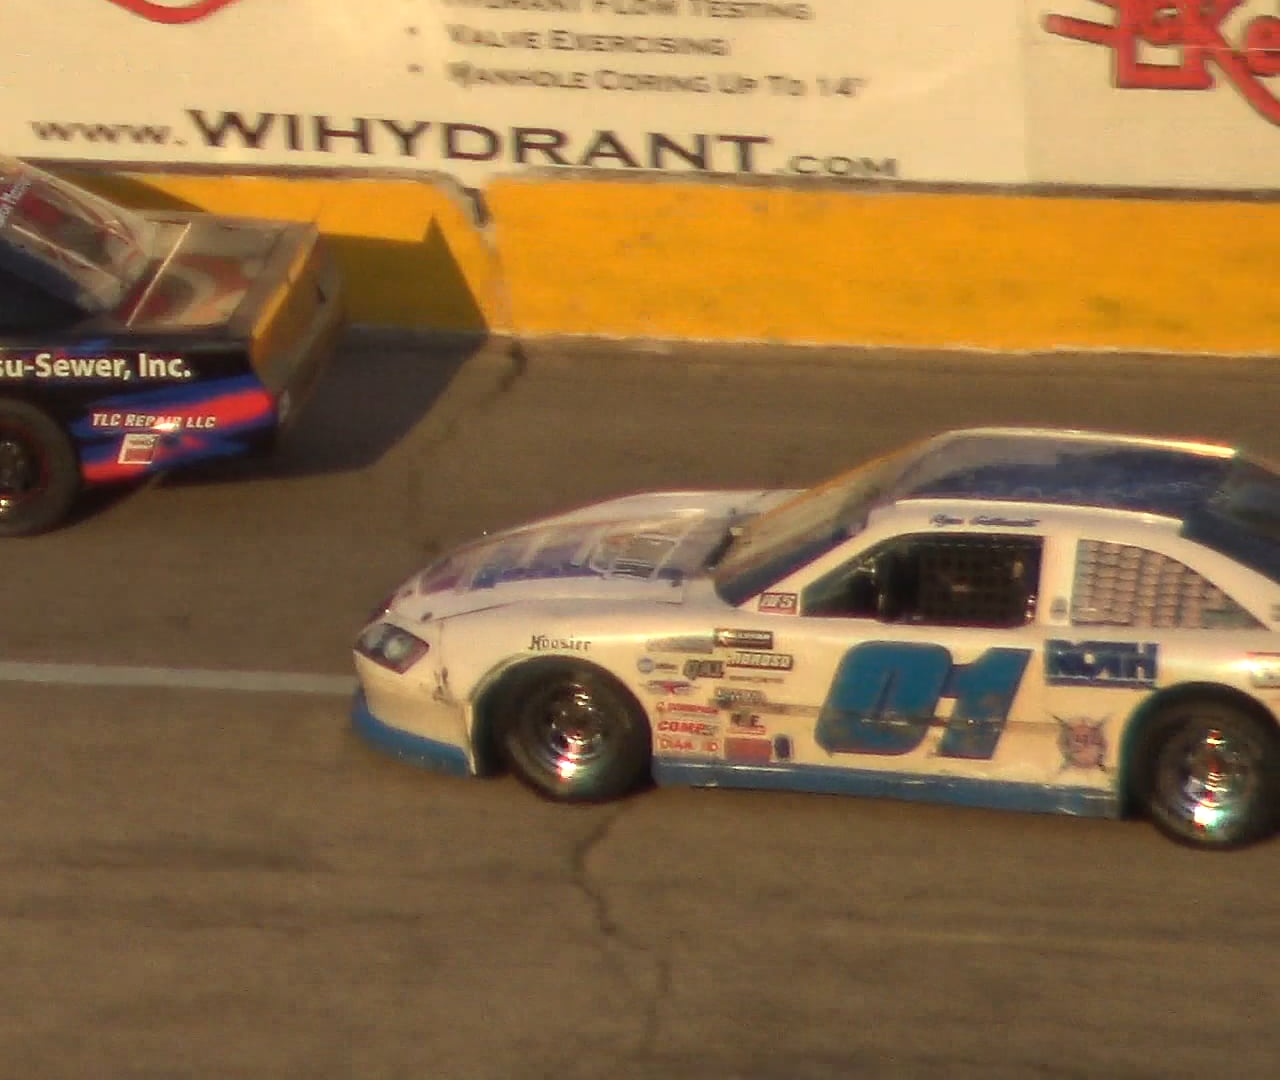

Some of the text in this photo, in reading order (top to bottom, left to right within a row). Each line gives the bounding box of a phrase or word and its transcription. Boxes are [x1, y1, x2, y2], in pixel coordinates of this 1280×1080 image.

[139, 352, 192, 379] Inc.
[528, 634, 592, 653] Hoosier
[814, 639, 1035, 761] 01
